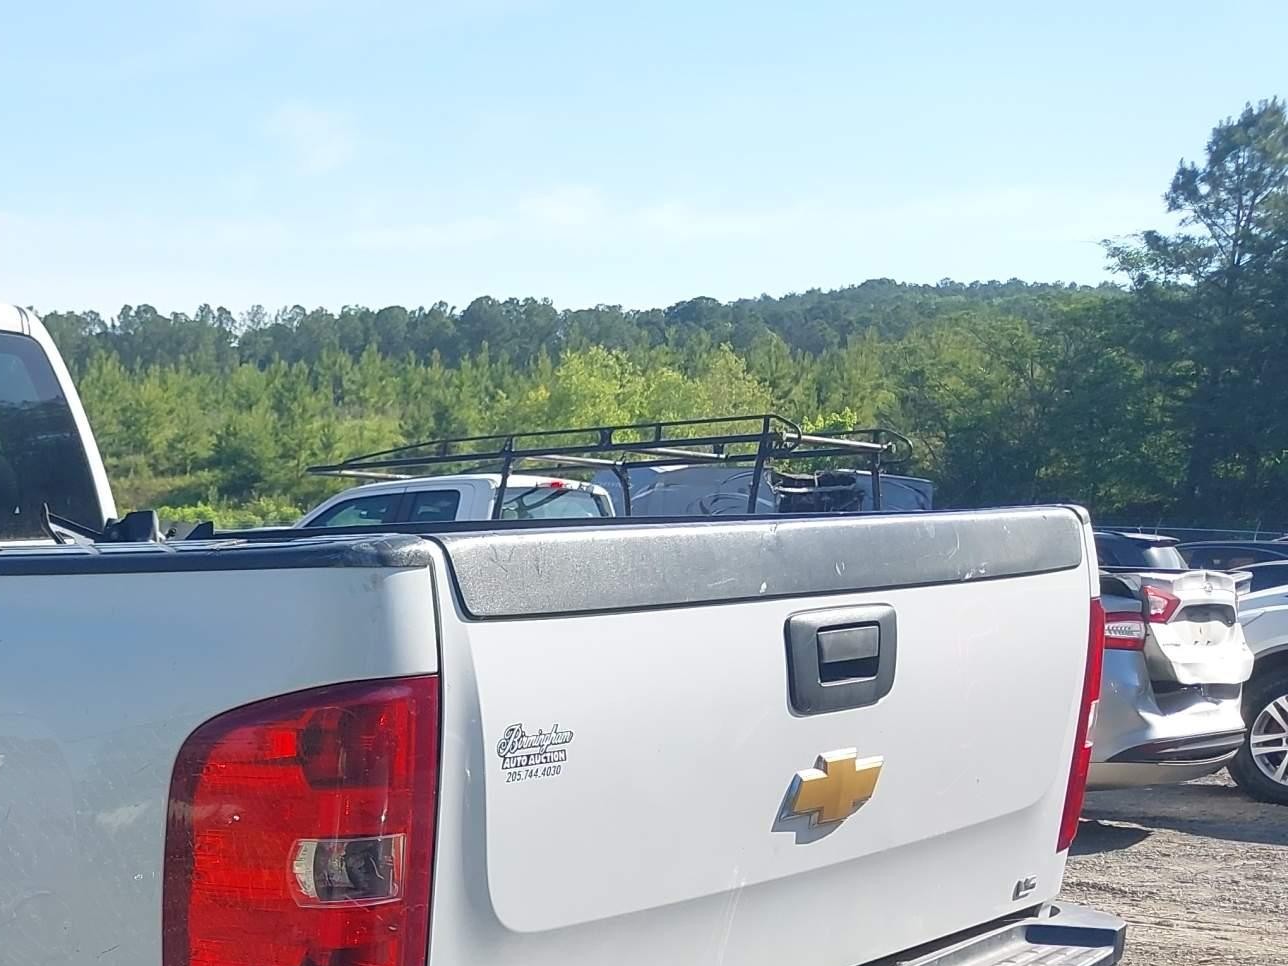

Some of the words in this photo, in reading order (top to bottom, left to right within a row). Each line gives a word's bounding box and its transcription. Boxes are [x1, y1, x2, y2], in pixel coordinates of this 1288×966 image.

[497, 722, 574, 757] Birmingham
[503, 756, 528, 769] AUTO
[529, 751, 566, 766] AUCTION
[506, 764, 561, 783] 205.744.4030
